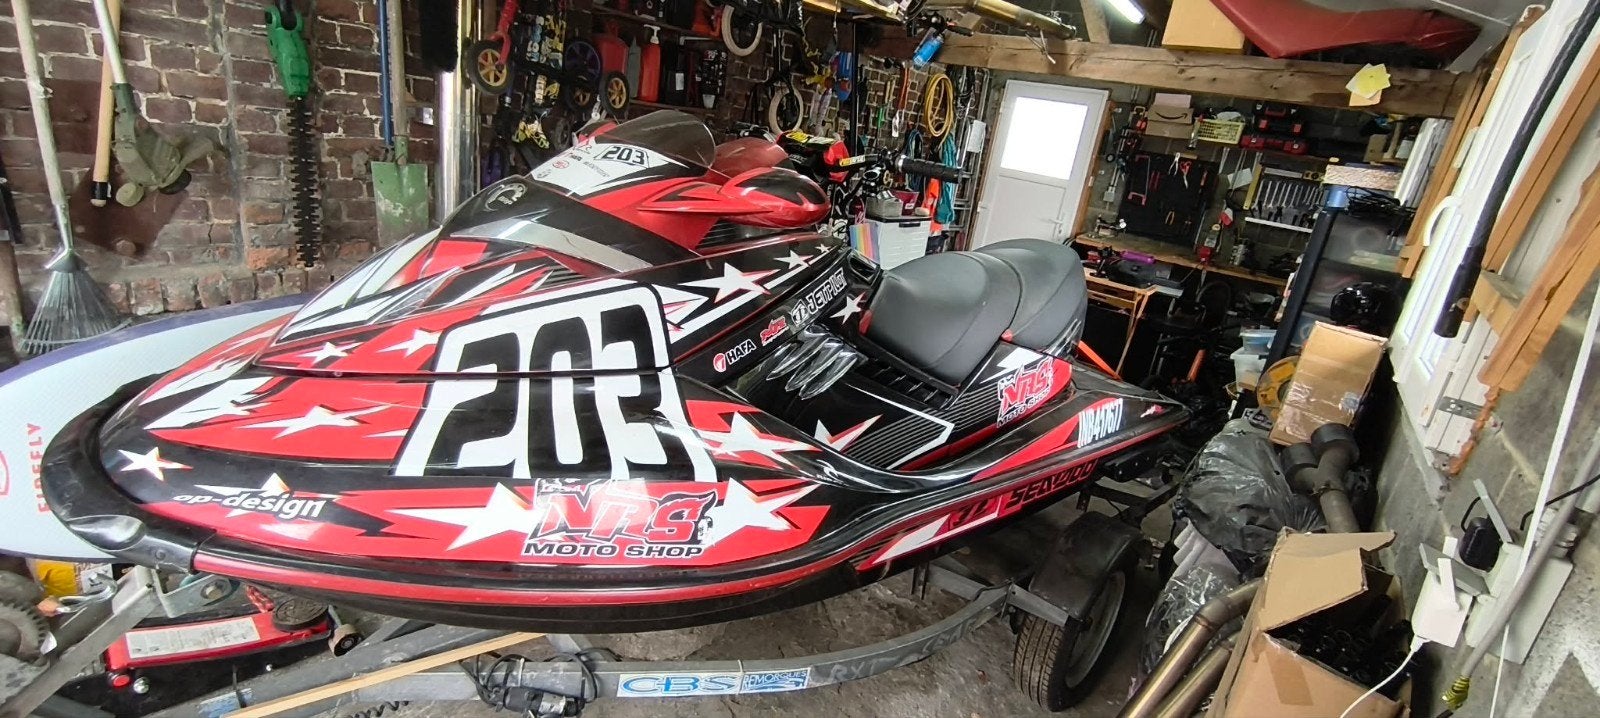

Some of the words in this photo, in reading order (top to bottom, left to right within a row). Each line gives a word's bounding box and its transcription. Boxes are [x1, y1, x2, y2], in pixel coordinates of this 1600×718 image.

[602, 146, 646, 166] 203
[725, 338, 757, 365] HAFA
[423, 304, 695, 481] 203
[1001, 357, 1053, 415] NRS
[997, 404, 1027, 428] MOTO
[538, 488, 708, 543] NRS
[523, 542, 618, 558] MOTO
[625, 544, 705, 558] SHOP
[622, 676, 737, 694] CBS
